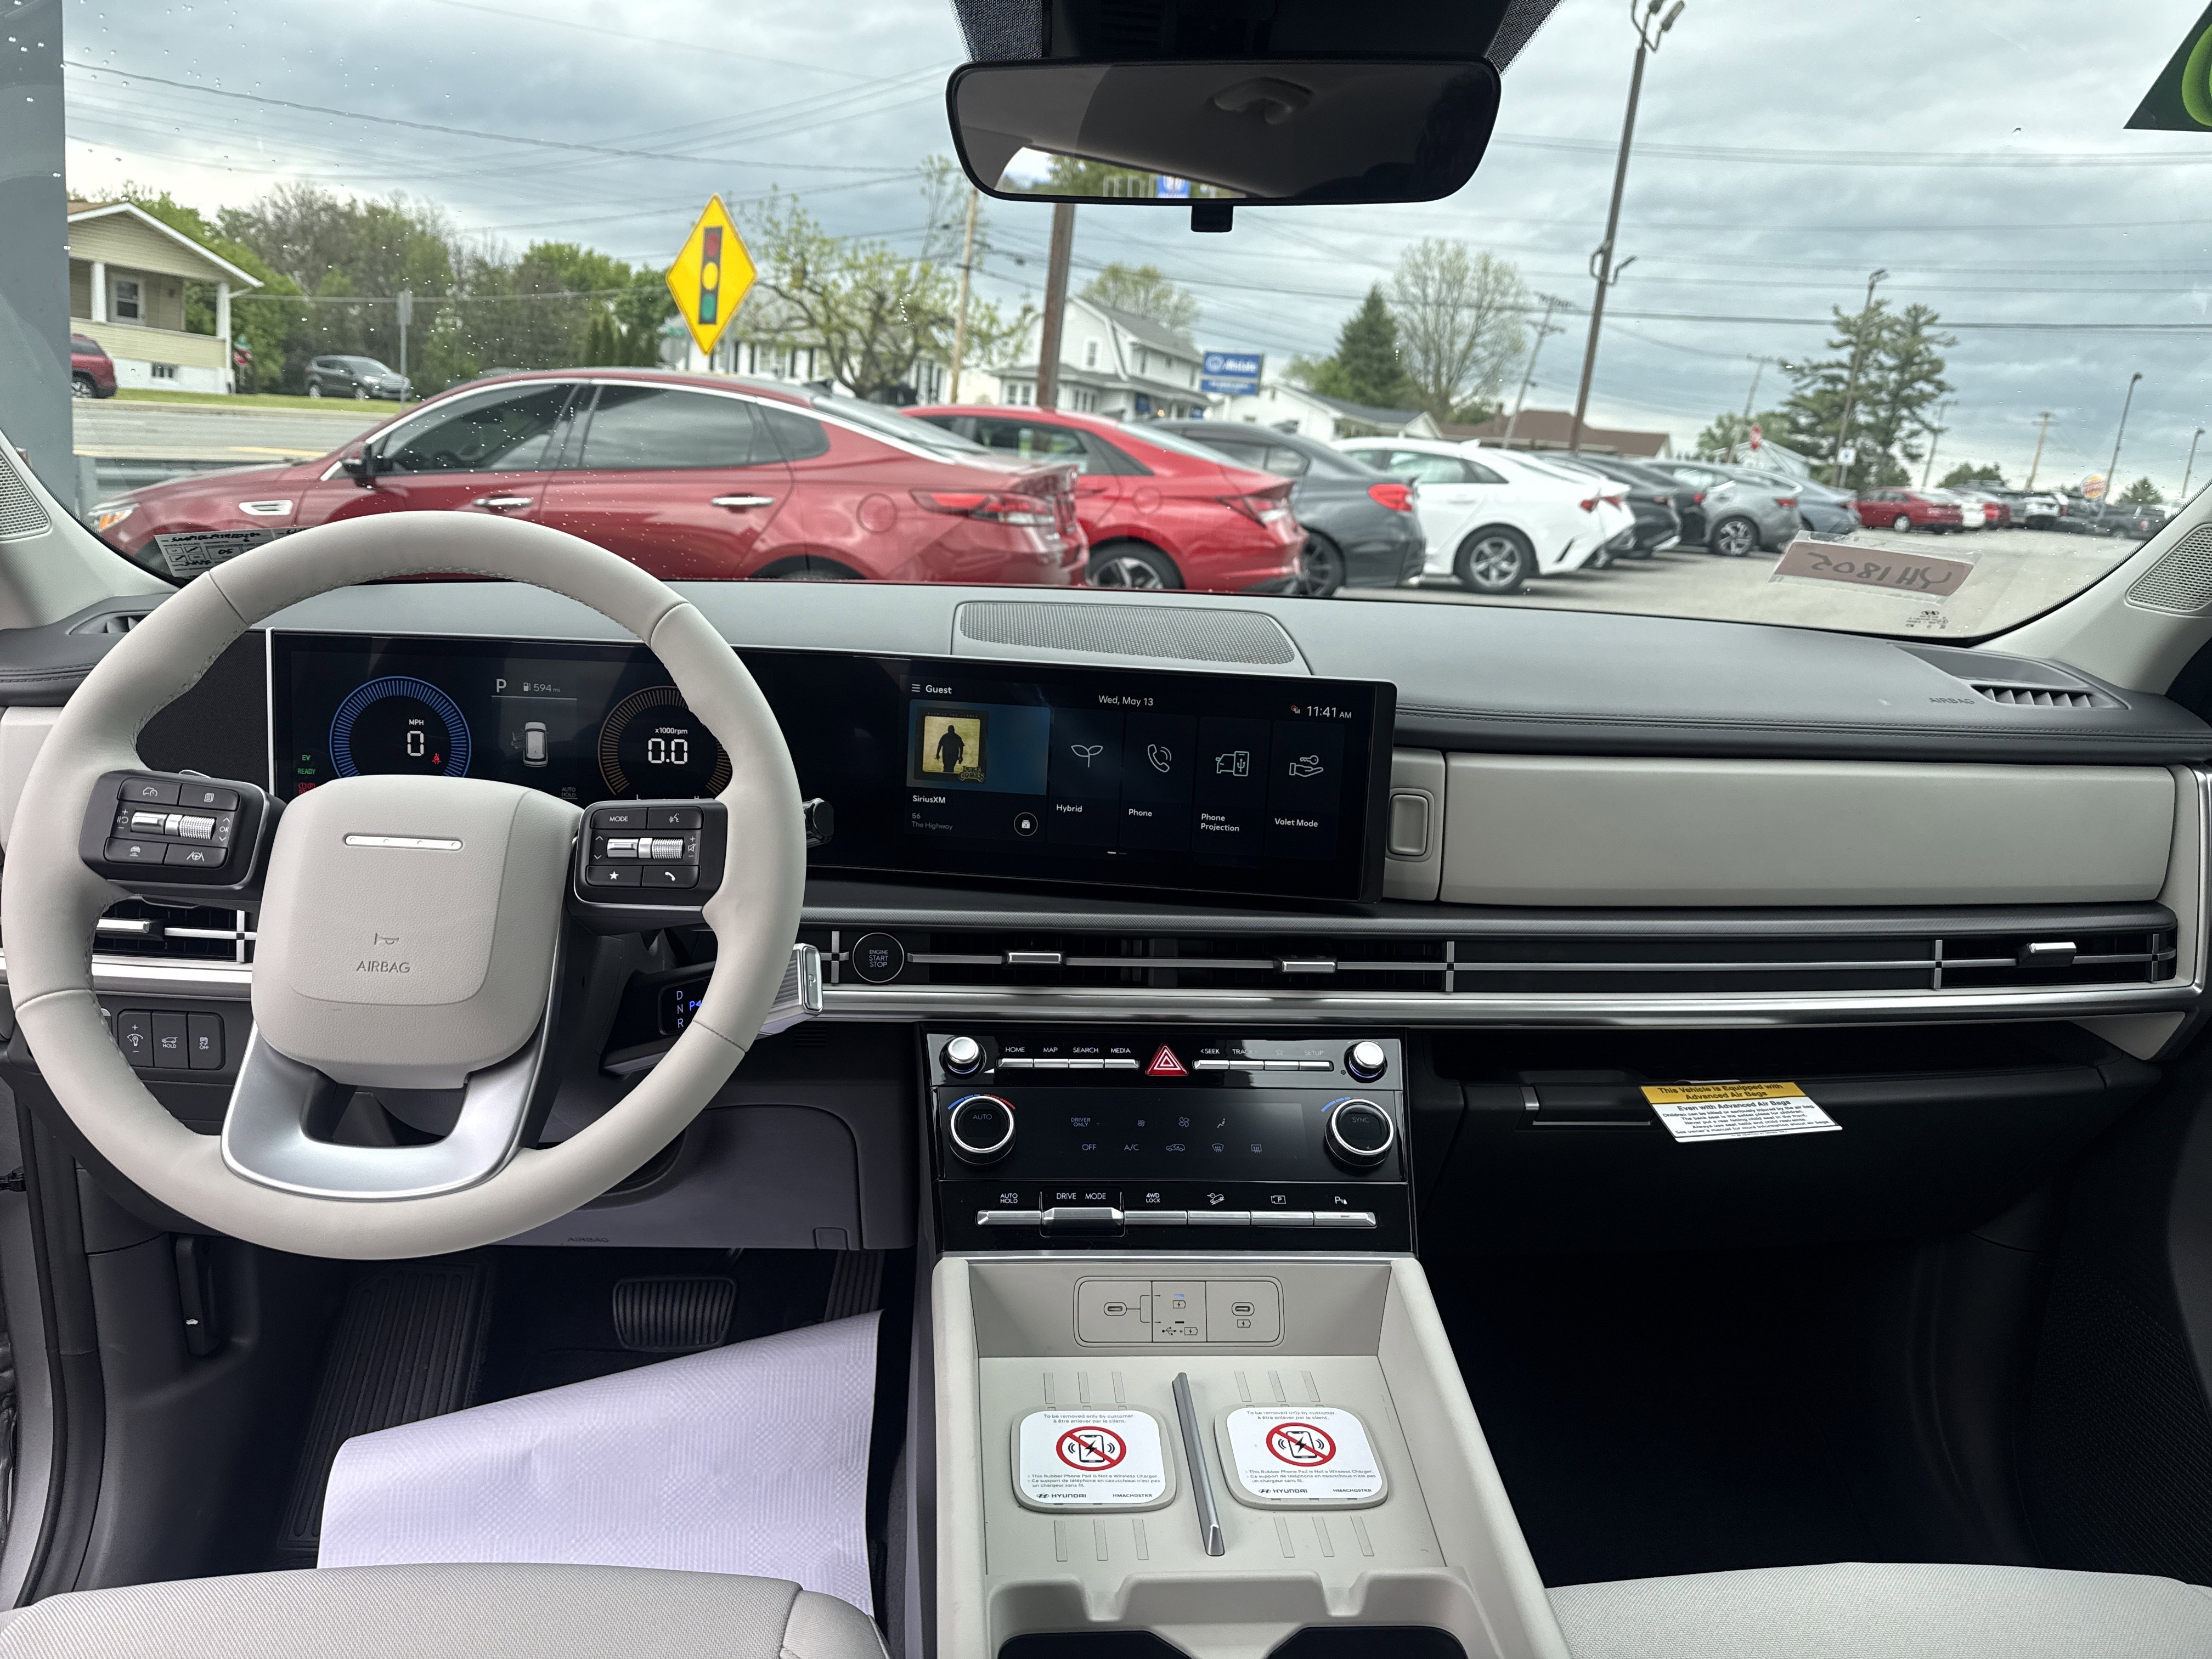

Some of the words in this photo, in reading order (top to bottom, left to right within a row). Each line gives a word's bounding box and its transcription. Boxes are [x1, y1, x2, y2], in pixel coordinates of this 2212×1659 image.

[496, 679, 507, 693] P
[534, 684, 551, 692] 594
[926, 685, 952, 694] Guest
[1098, 695, 1120, 705] Wed,
[1122, 696, 1141, 707] May
[1143, 698, 1153, 706] 13
[1306, 706, 1337, 718] 11:41
[407, 730, 424, 757] 0
[648, 738, 688, 764] 0.0
[913, 795, 946, 804] SiriusXM
[1056, 804, 1082, 813] Hybrid
[1128, 809, 1152, 817] Phone
[1274, 817, 1295, 826] Valet
[1296, 819, 1318, 827] Mode
[1201, 823, 1239, 832] Projection
[356, 961, 410, 973] AIRBAG
[676, 991, 683, 1000] D
[677, 1005, 684, 1014] N
[689, 1001, 695, 1011] P
[678, 1018, 684, 1028] R
